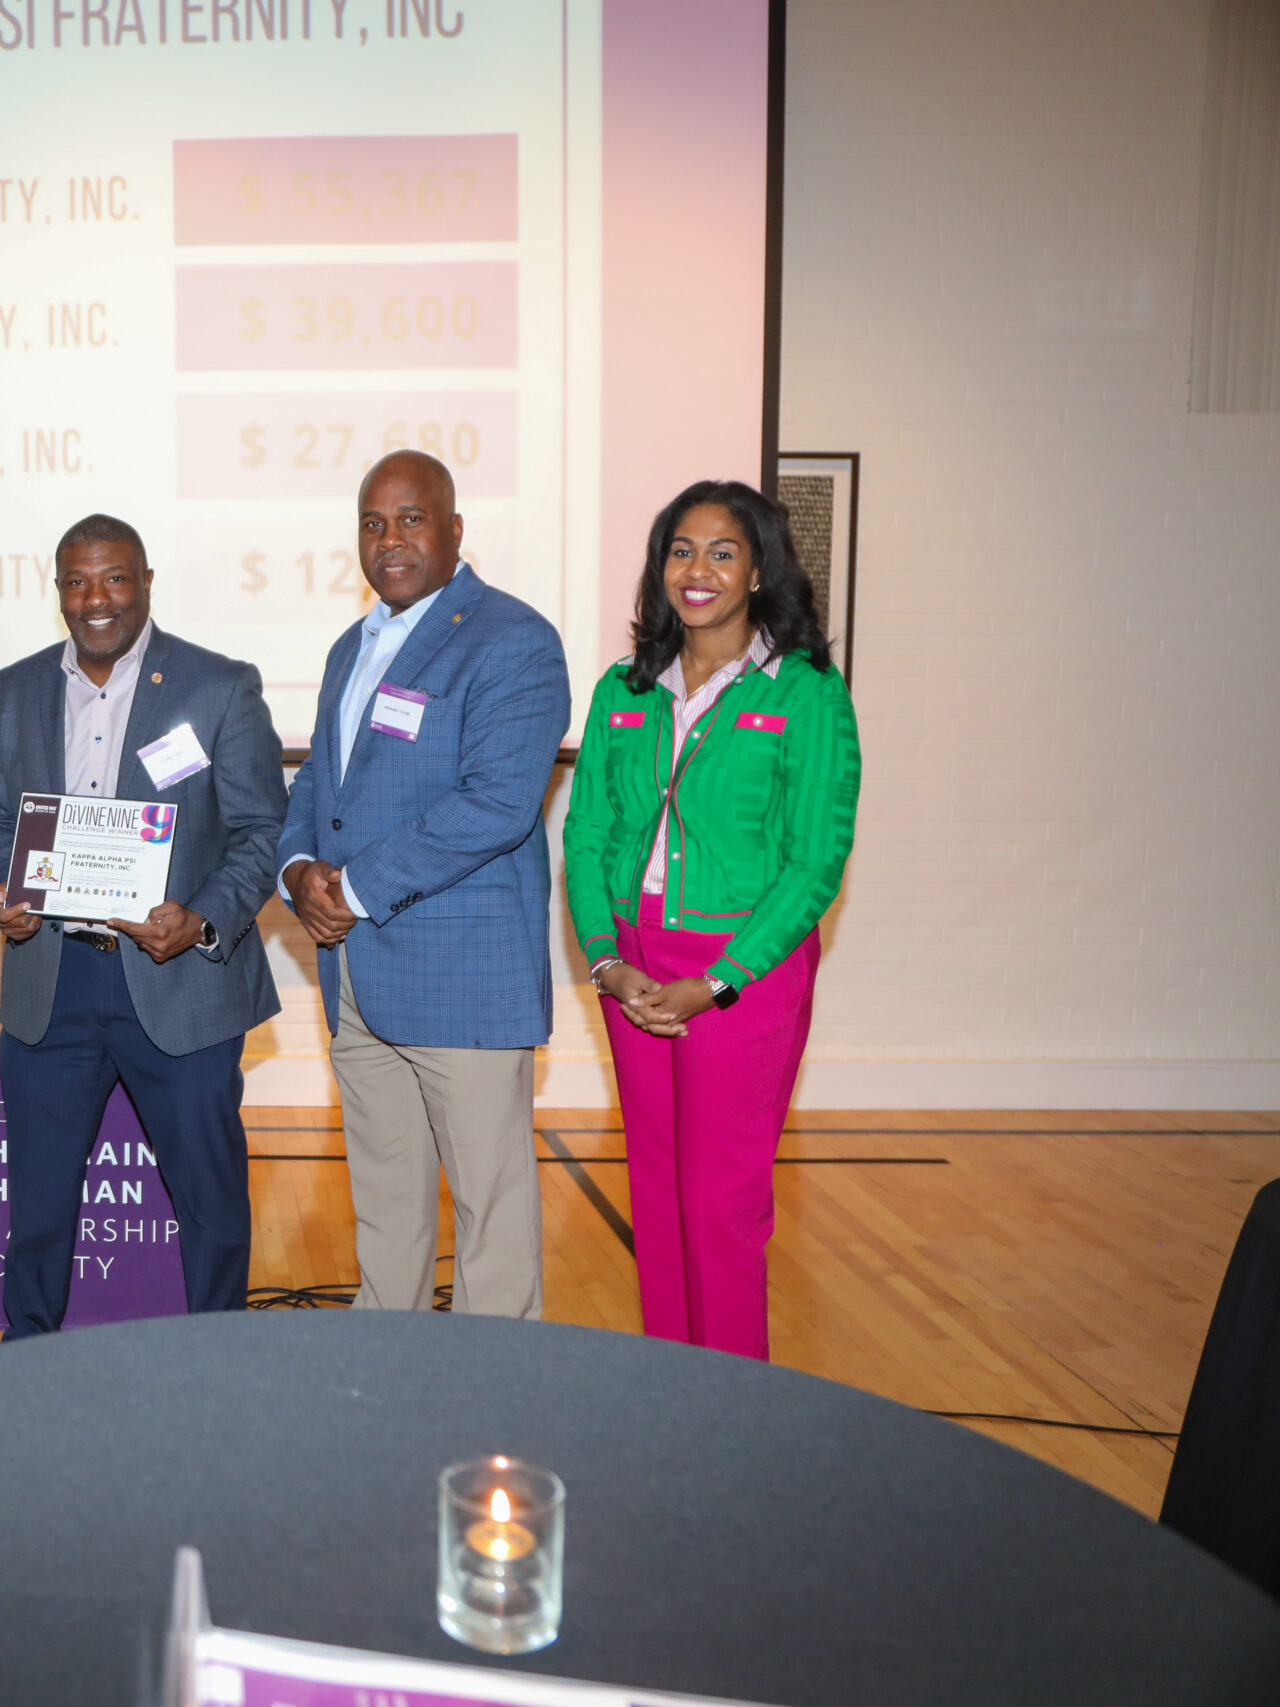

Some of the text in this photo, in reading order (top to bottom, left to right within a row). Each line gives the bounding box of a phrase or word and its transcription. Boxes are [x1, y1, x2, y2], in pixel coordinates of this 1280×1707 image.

[53, 0, 370, 49] FRATERNITY,
[69, 175, 140, 222] INC.
[289, 168, 480, 223] 55,367
[47, 302, 120, 349] INC.
[238, 293, 481, 351] $ 39,600
[22, 428, 94, 476] INC.
[238, 422, 268, 475] $
[239, 548, 269, 598] $
[61, 824, 139, 836] CHALLENGE WINNER
[70, 860, 117, 870] FRATERNITY,
[98, 855, 122, 863] ALPHA
